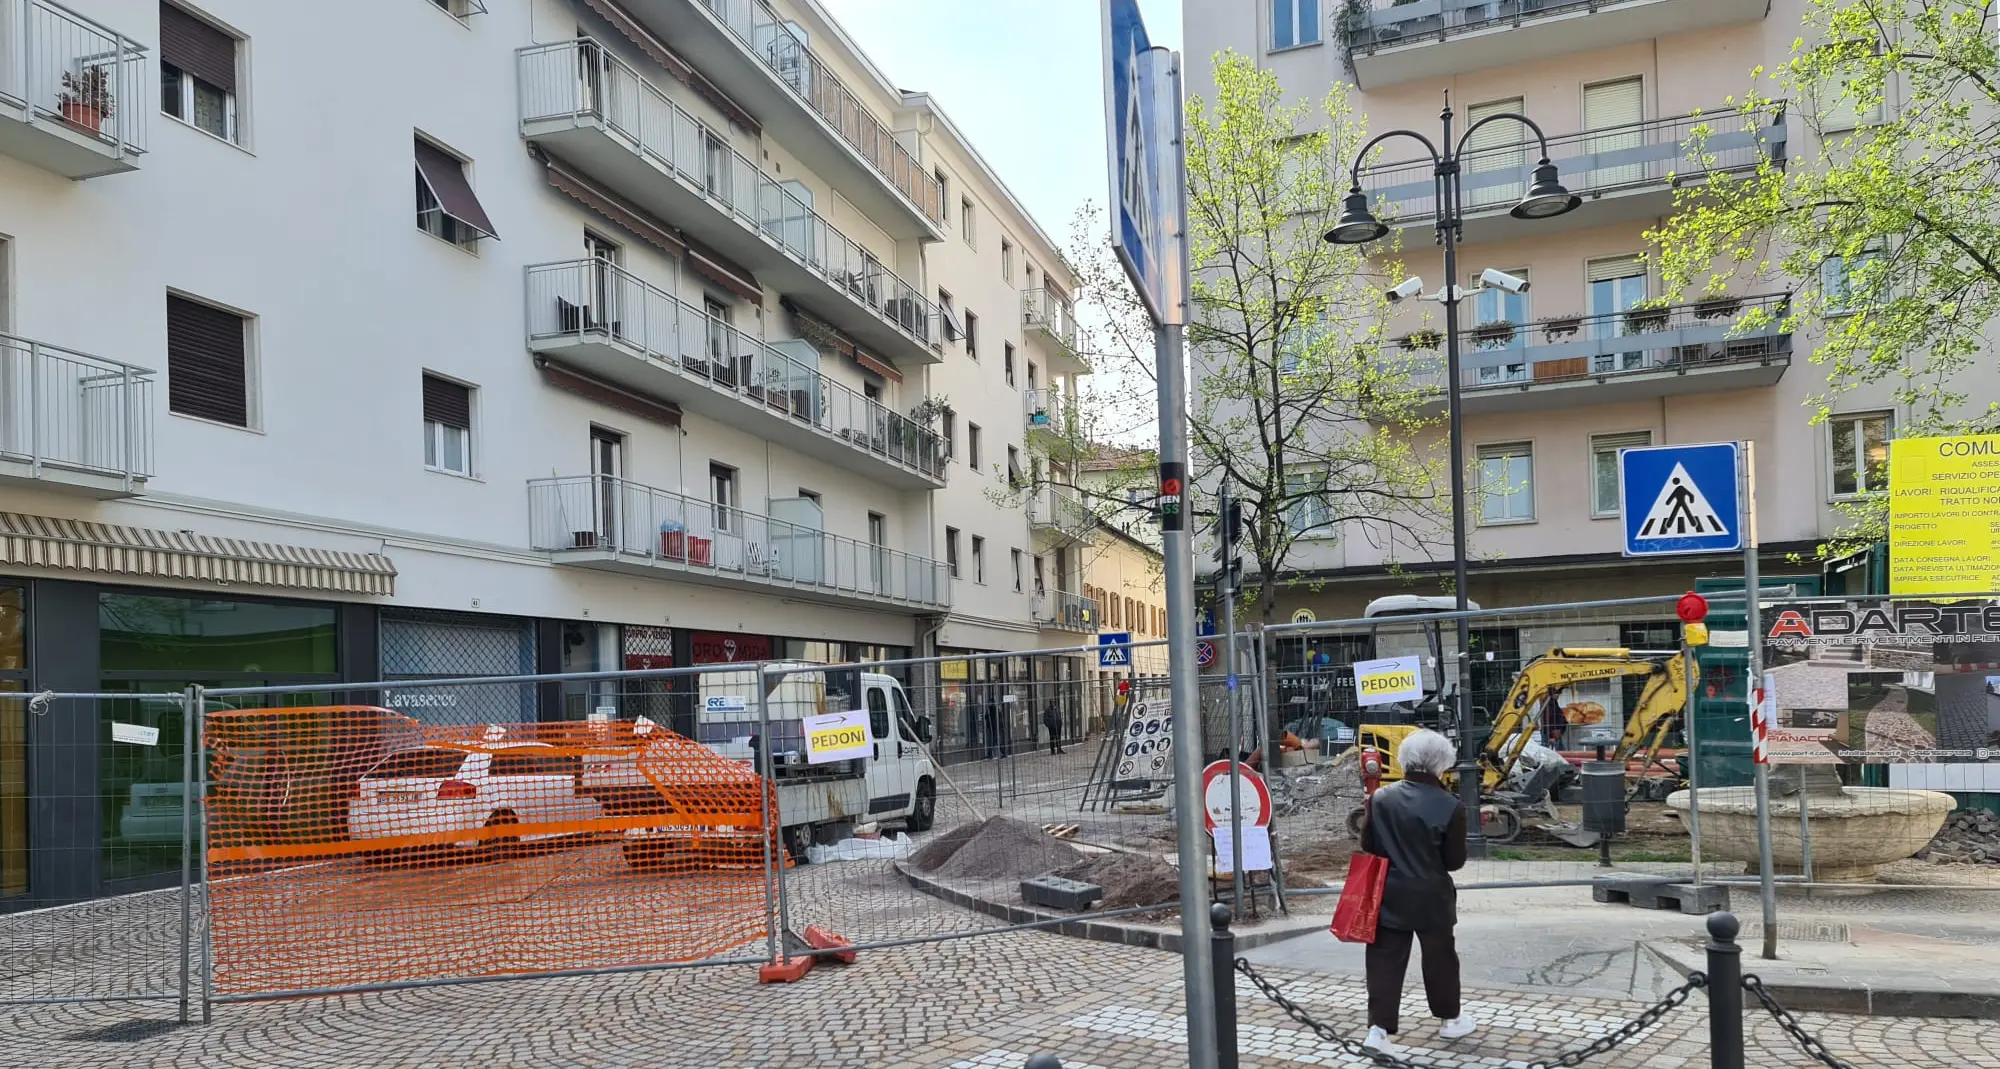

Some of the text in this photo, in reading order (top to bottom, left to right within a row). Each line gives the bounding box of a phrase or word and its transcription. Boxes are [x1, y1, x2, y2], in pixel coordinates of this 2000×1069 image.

[1940, 440, 2000, 457] COMU
[1932, 471, 2000, 481] SERVIZIO OPE
[1940, 496, 2000, 505] TRATTO NO
[1767, 637, 1839, 646] PAVIMENTI
[1856, 635, 1955, 645] RIVESTIMENTI
[1956, 633, 1970, 643] IN
[692, 642, 722, 658] ORO
[1361, 674, 1415, 692] PEDONI
[384, 689, 457, 707] Lavasecco
[811, 728, 866, 749] PEDONI
